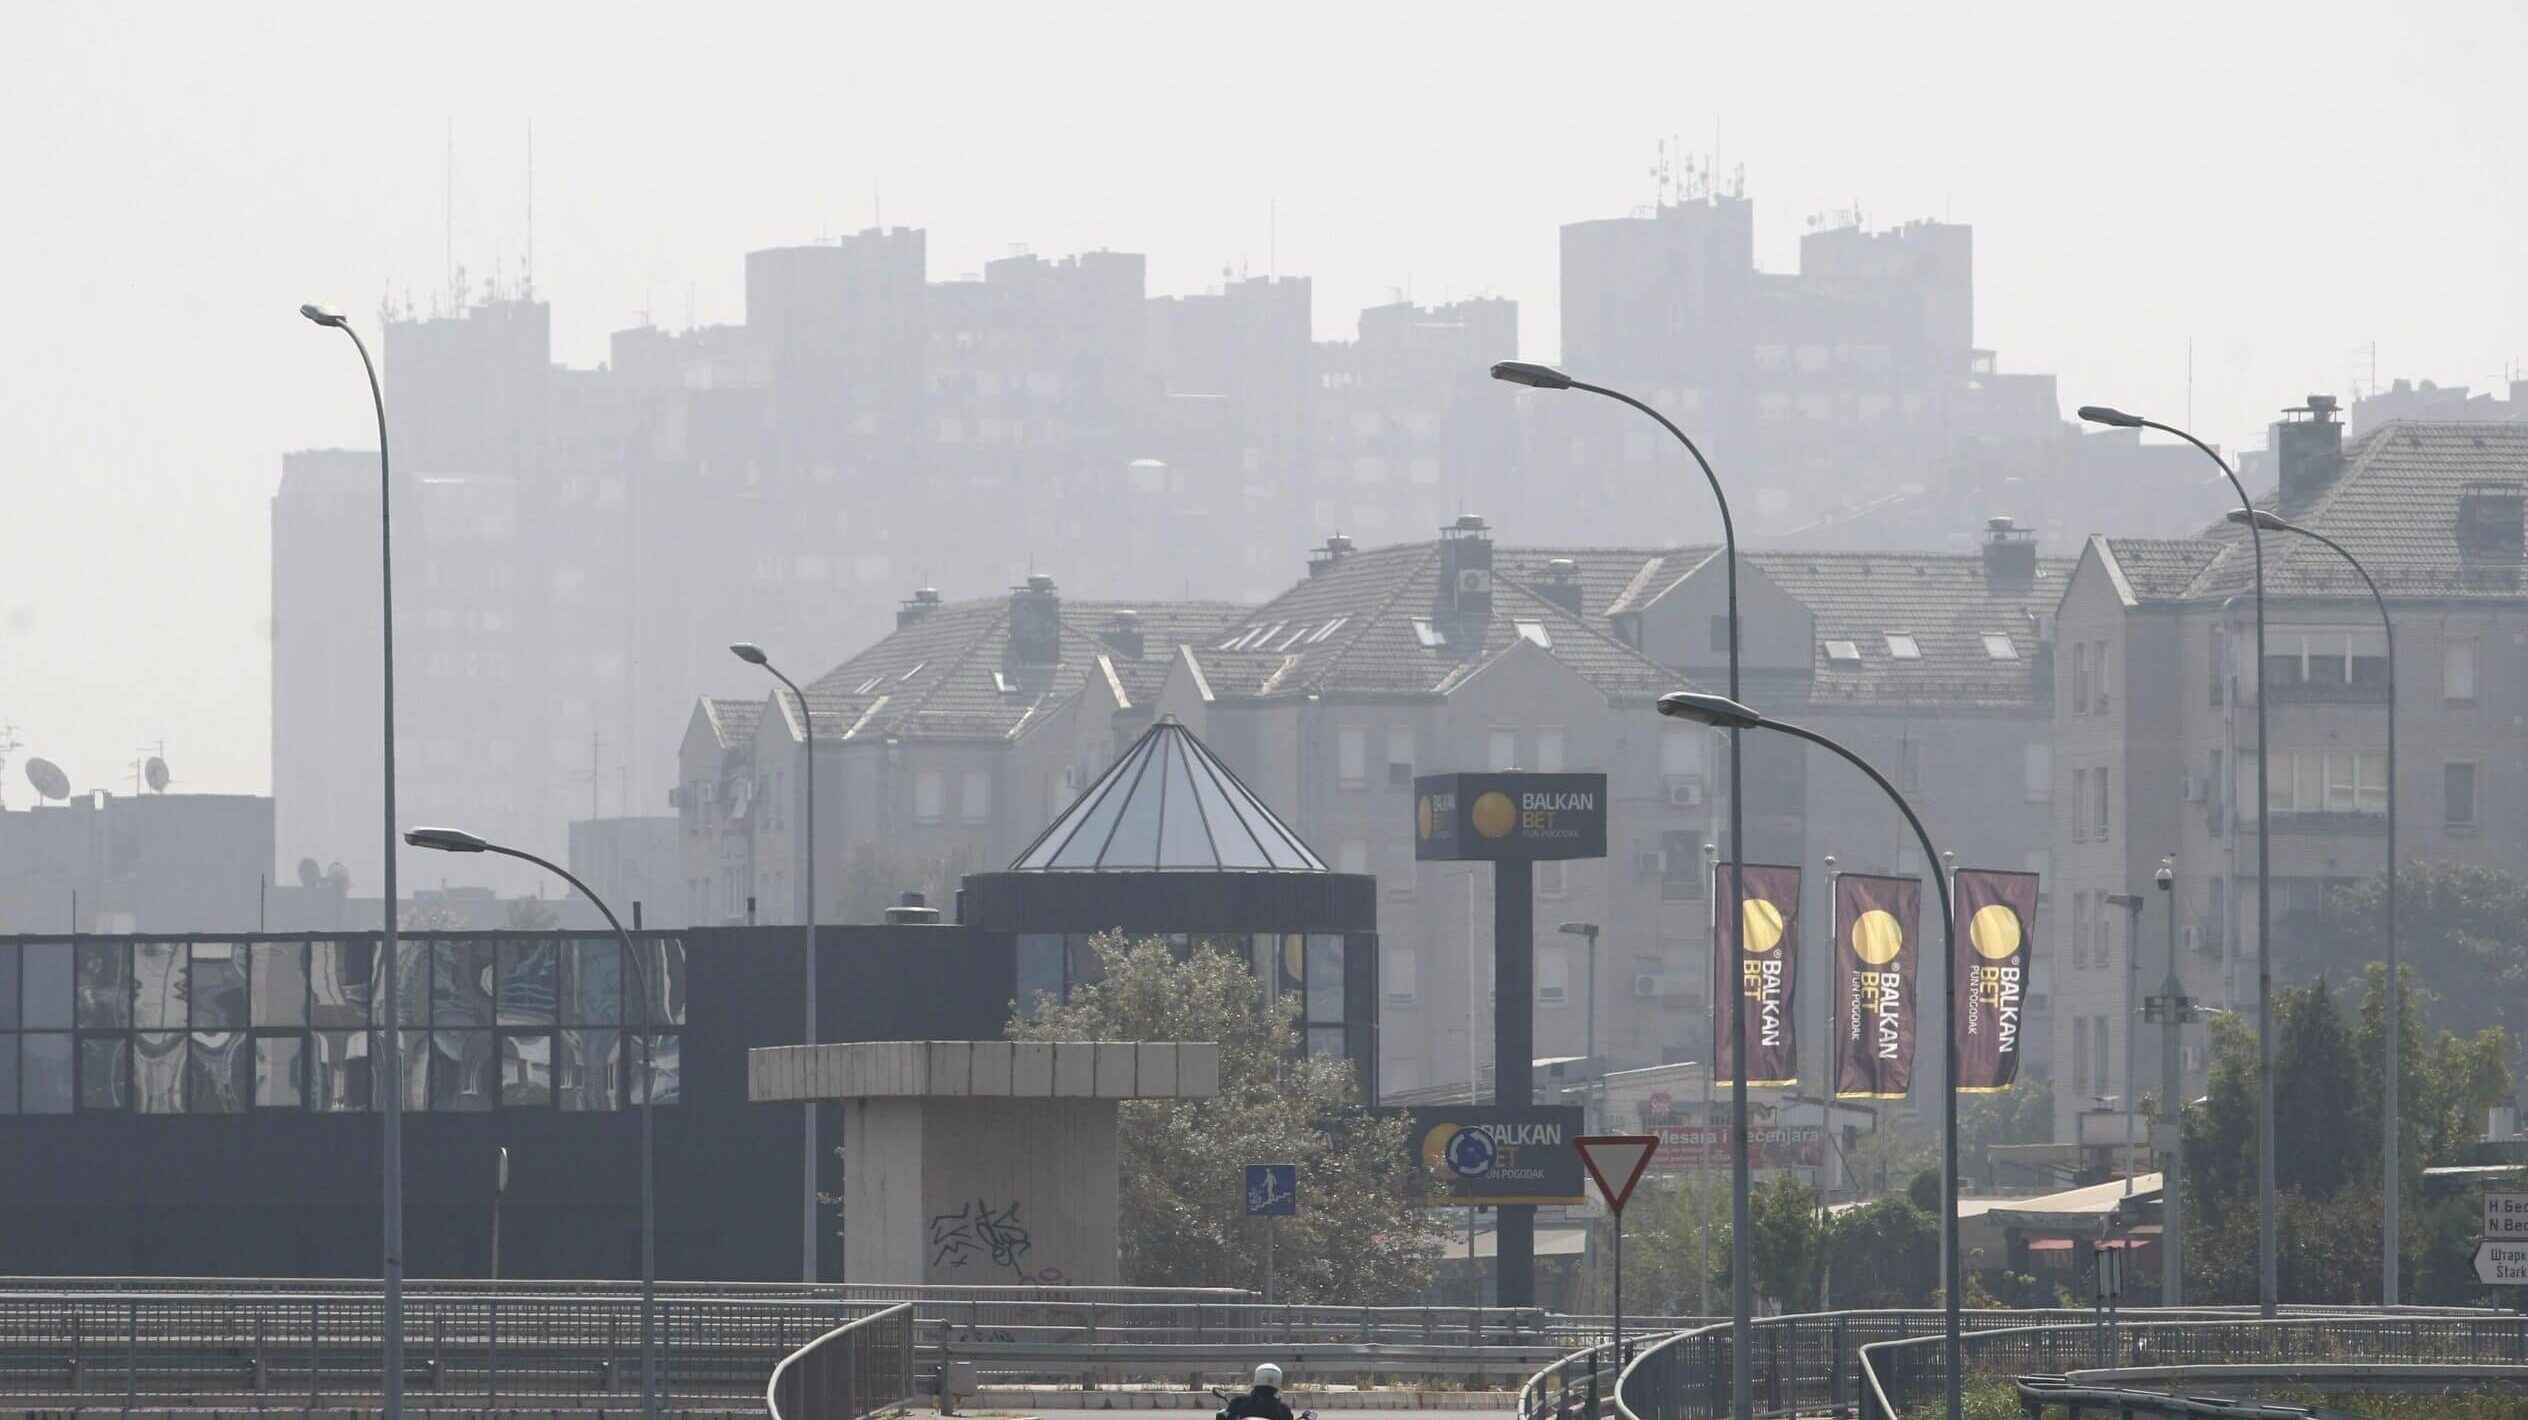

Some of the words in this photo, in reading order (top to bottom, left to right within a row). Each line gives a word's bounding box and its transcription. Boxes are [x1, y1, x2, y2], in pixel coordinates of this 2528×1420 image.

[1522, 811, 1554, 829] BET
[1523, 792, 1593, 810] BALKAN
[1744, 960, 1761, 1002] BET
[1861, 972, 1880, 1014] BET
[1970, 964, 1980, 986] PUN
[1980, 966, 1999, 1009] BET
[1761, 960, 1782, 1046] BALKAN
[1851, 994, 1861, 1041] POGODAK
[1879, 972, 1900, 1059] BALKAN
[1968, 988, 1979, 1035] POGODAK
[1999, 967, 2020, 1053] BALKAN
[1495, 1147, 1520, 1168] ET
[1746, 1128, 1819, 1146] ečenjara
[1502, 1169, 1545, 1179] POGODAK
